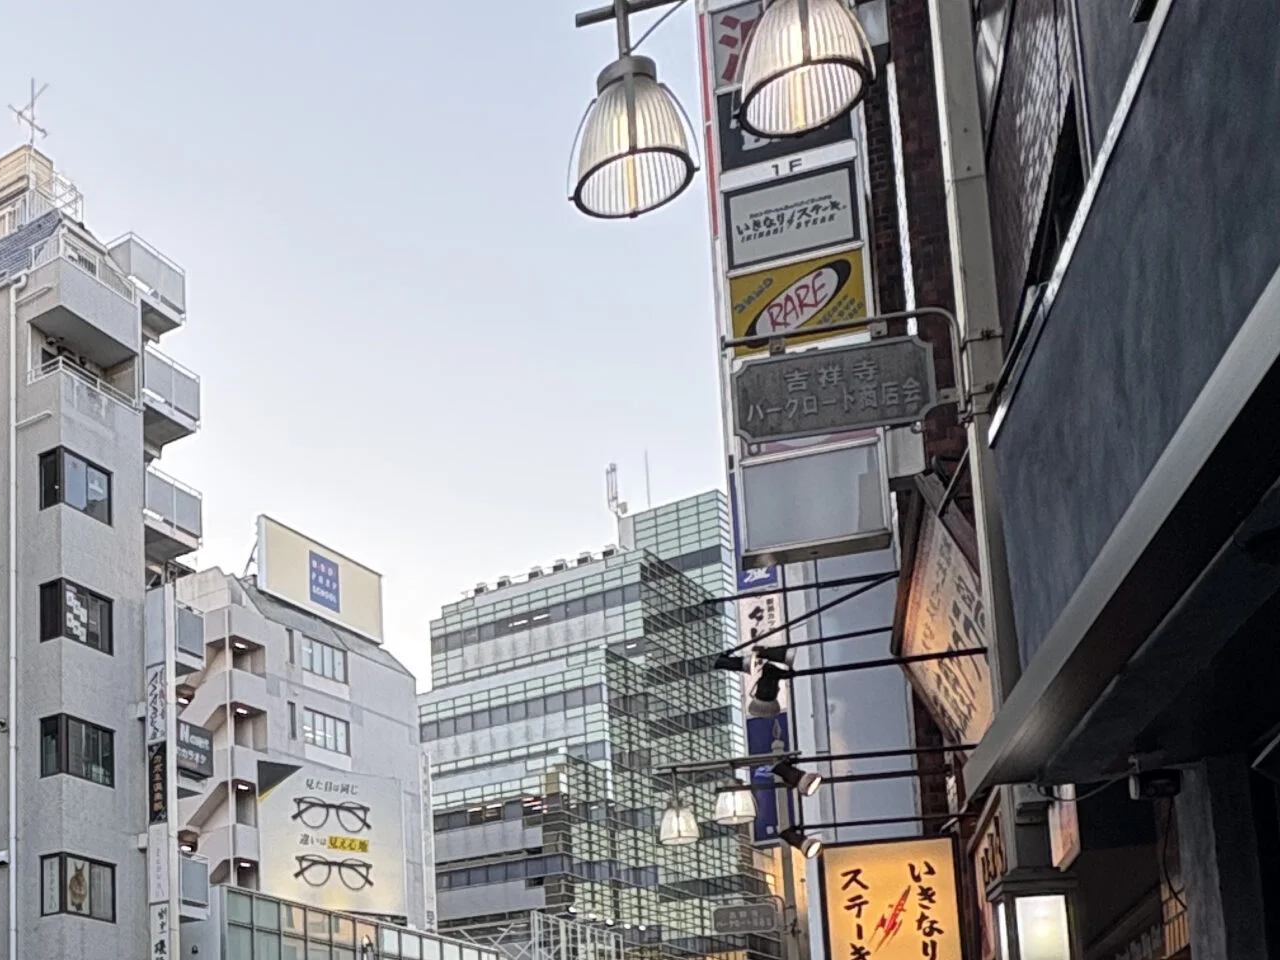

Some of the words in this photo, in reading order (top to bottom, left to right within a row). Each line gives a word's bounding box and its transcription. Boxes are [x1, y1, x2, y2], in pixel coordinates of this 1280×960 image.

[767, 270, 829, 333] RARE
[784, 359, 881, 393] 吉祥寺
